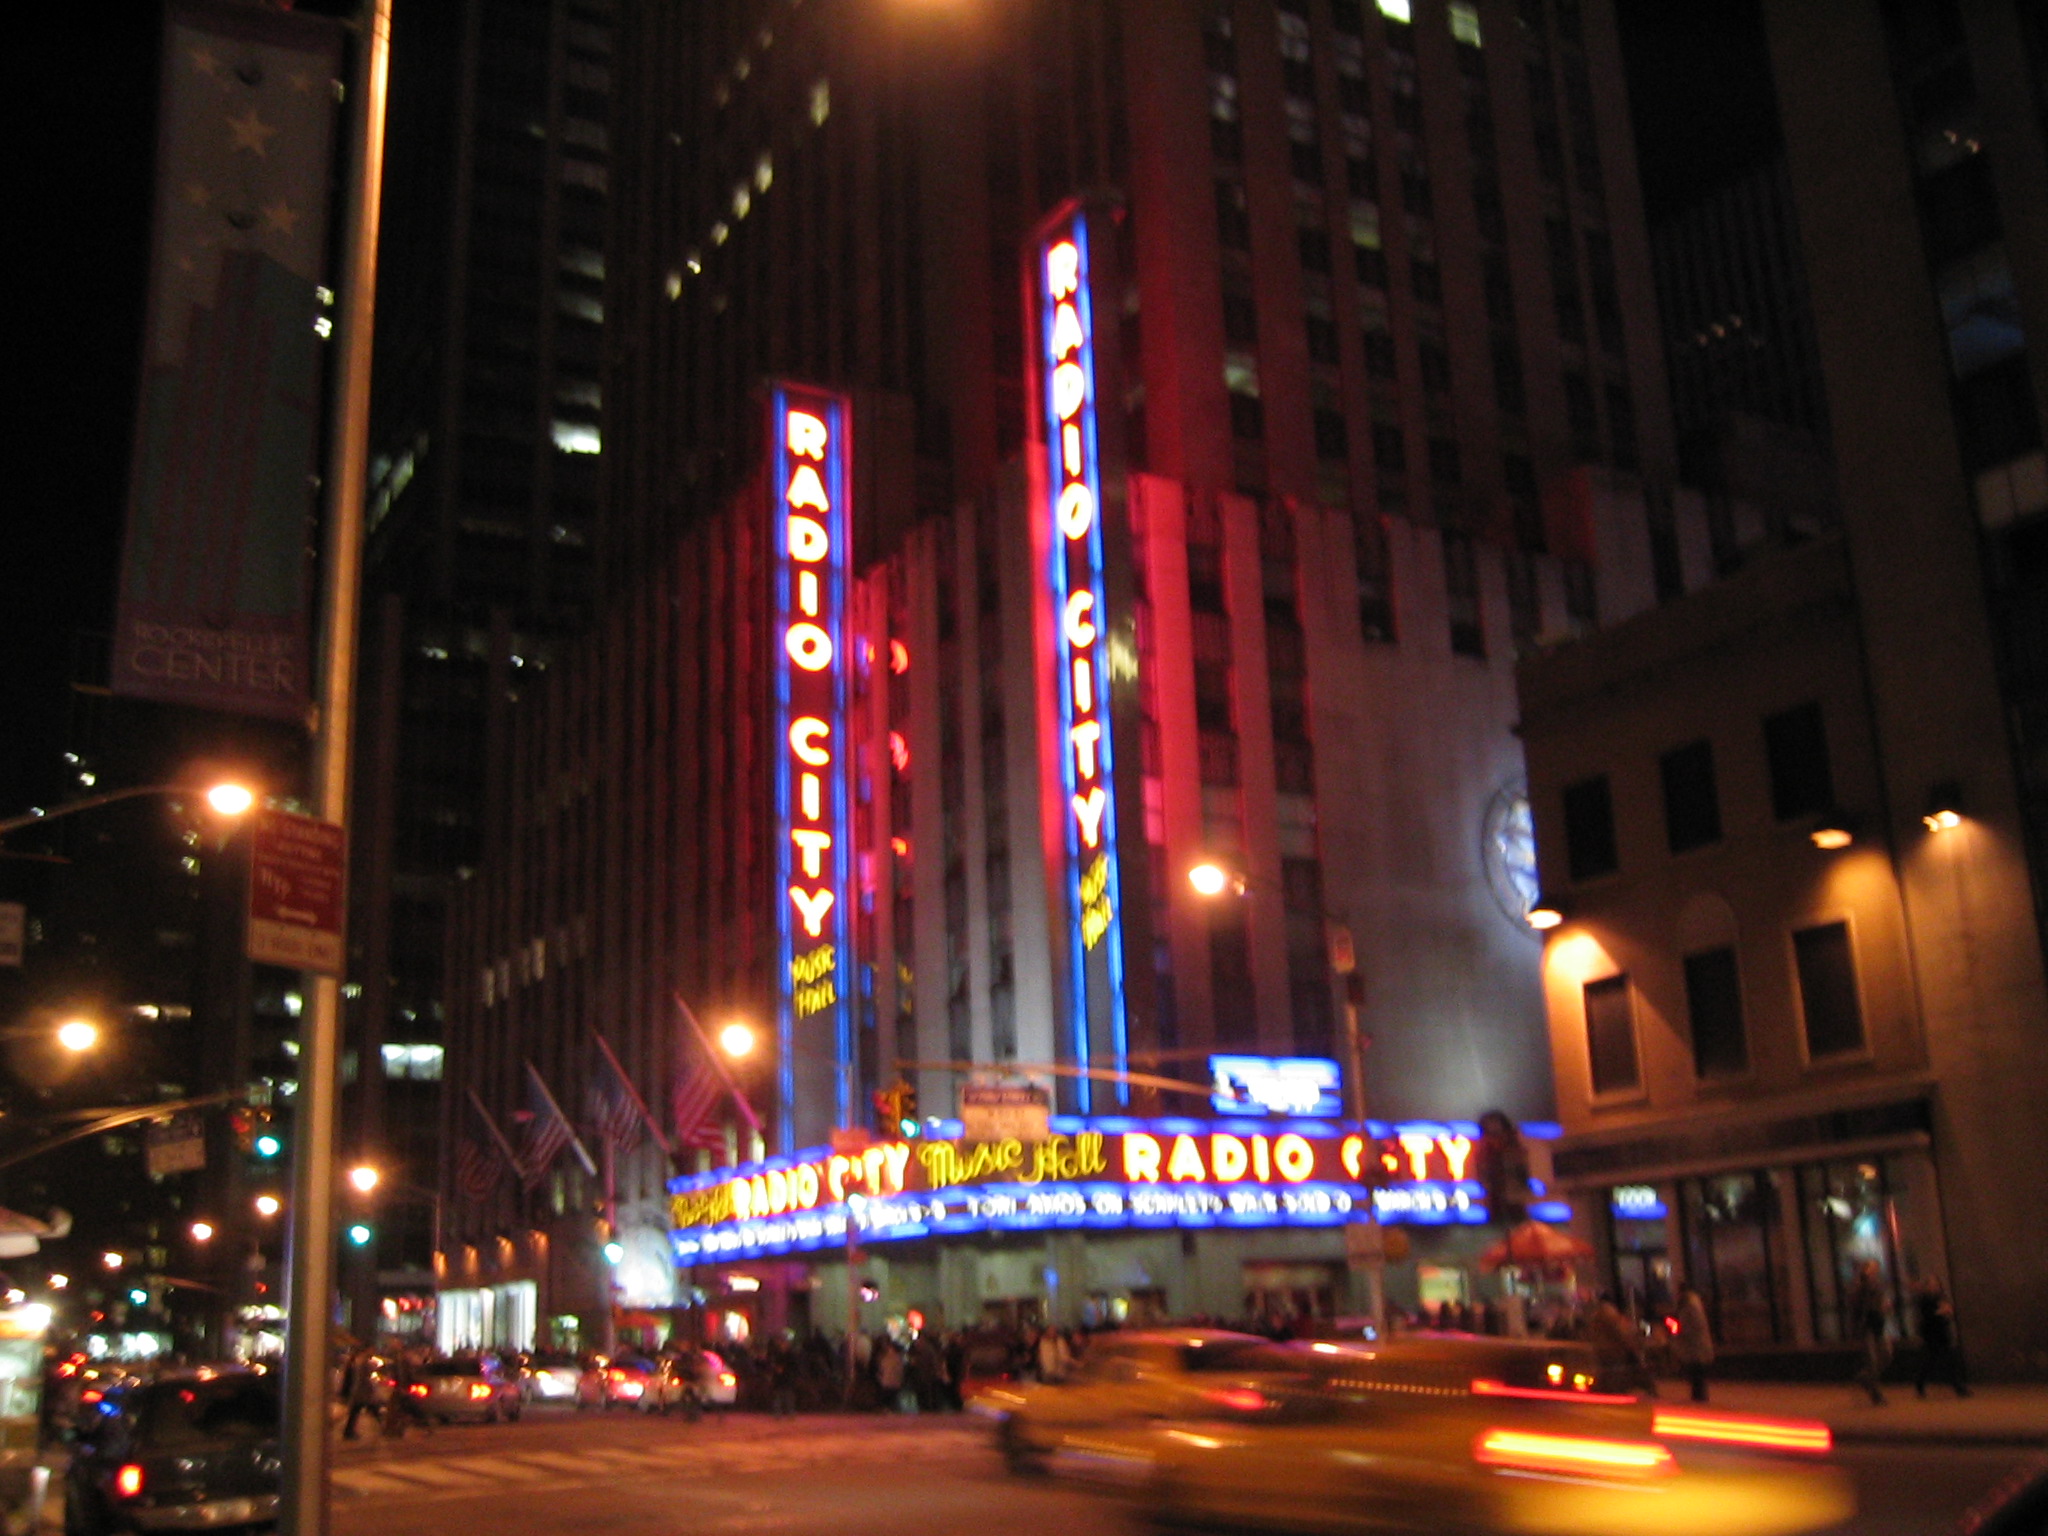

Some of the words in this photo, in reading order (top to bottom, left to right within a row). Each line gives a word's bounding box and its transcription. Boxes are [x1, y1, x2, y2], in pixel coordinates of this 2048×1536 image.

[1047, 241, 1094, 540] RADIO
[785, 410, 833, 671] RADIO
[131, 645, 296, 693] CENTER
[1064, 589, 1106, 849] CITY
[789, 716, 835, 937] CITY
[730, 1162, 819, 1222] RADIO
[1123, 1132, 1315, 1183] RADIO
